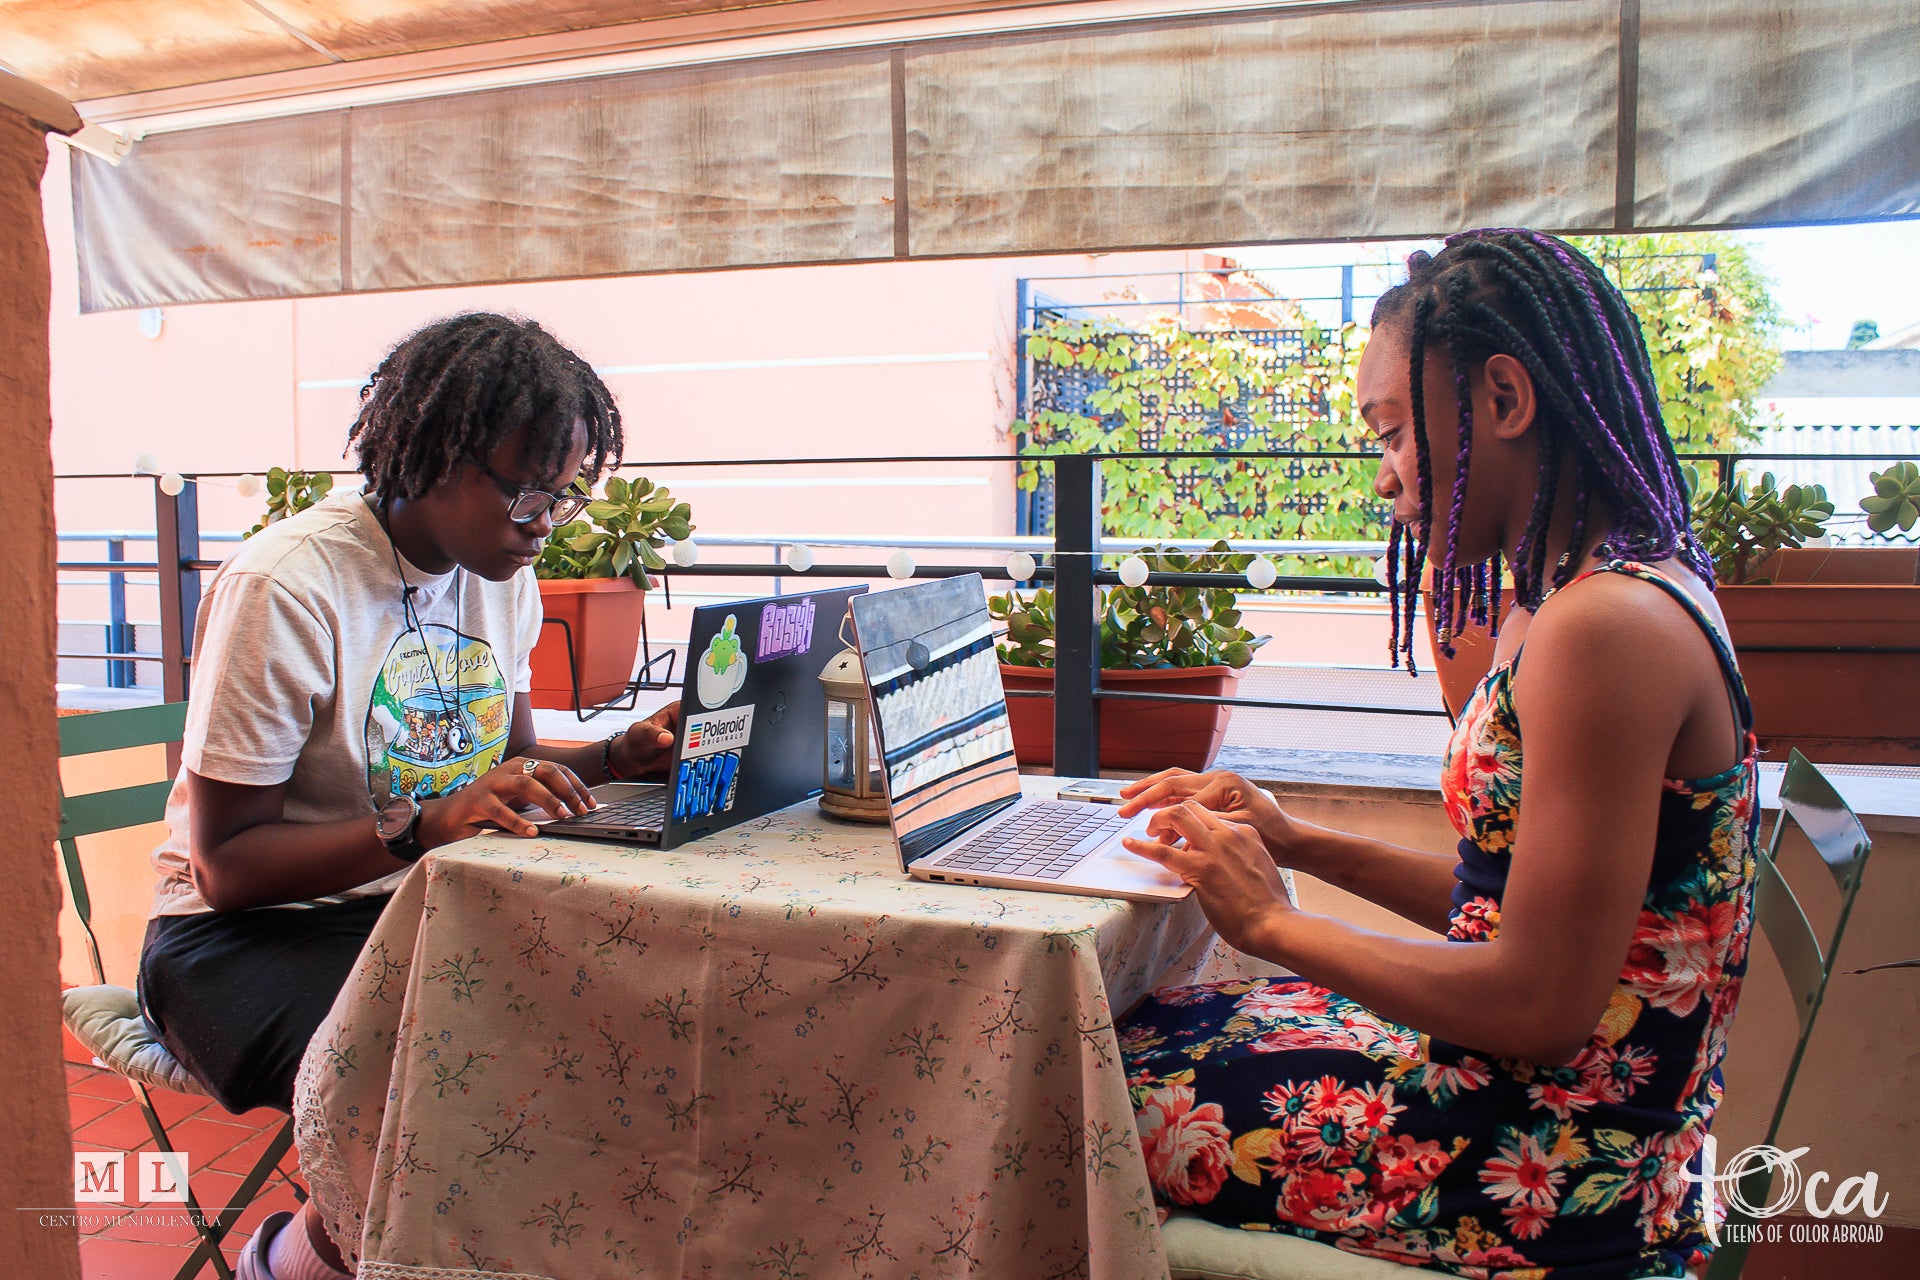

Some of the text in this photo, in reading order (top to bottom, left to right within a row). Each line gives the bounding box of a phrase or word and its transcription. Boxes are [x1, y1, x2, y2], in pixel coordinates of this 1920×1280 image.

[399, 648, 428, 660] EXCITING
[388, 643, 490, 696] Crystal Cove
[701, 732, 744, 747] ORIGINALS
